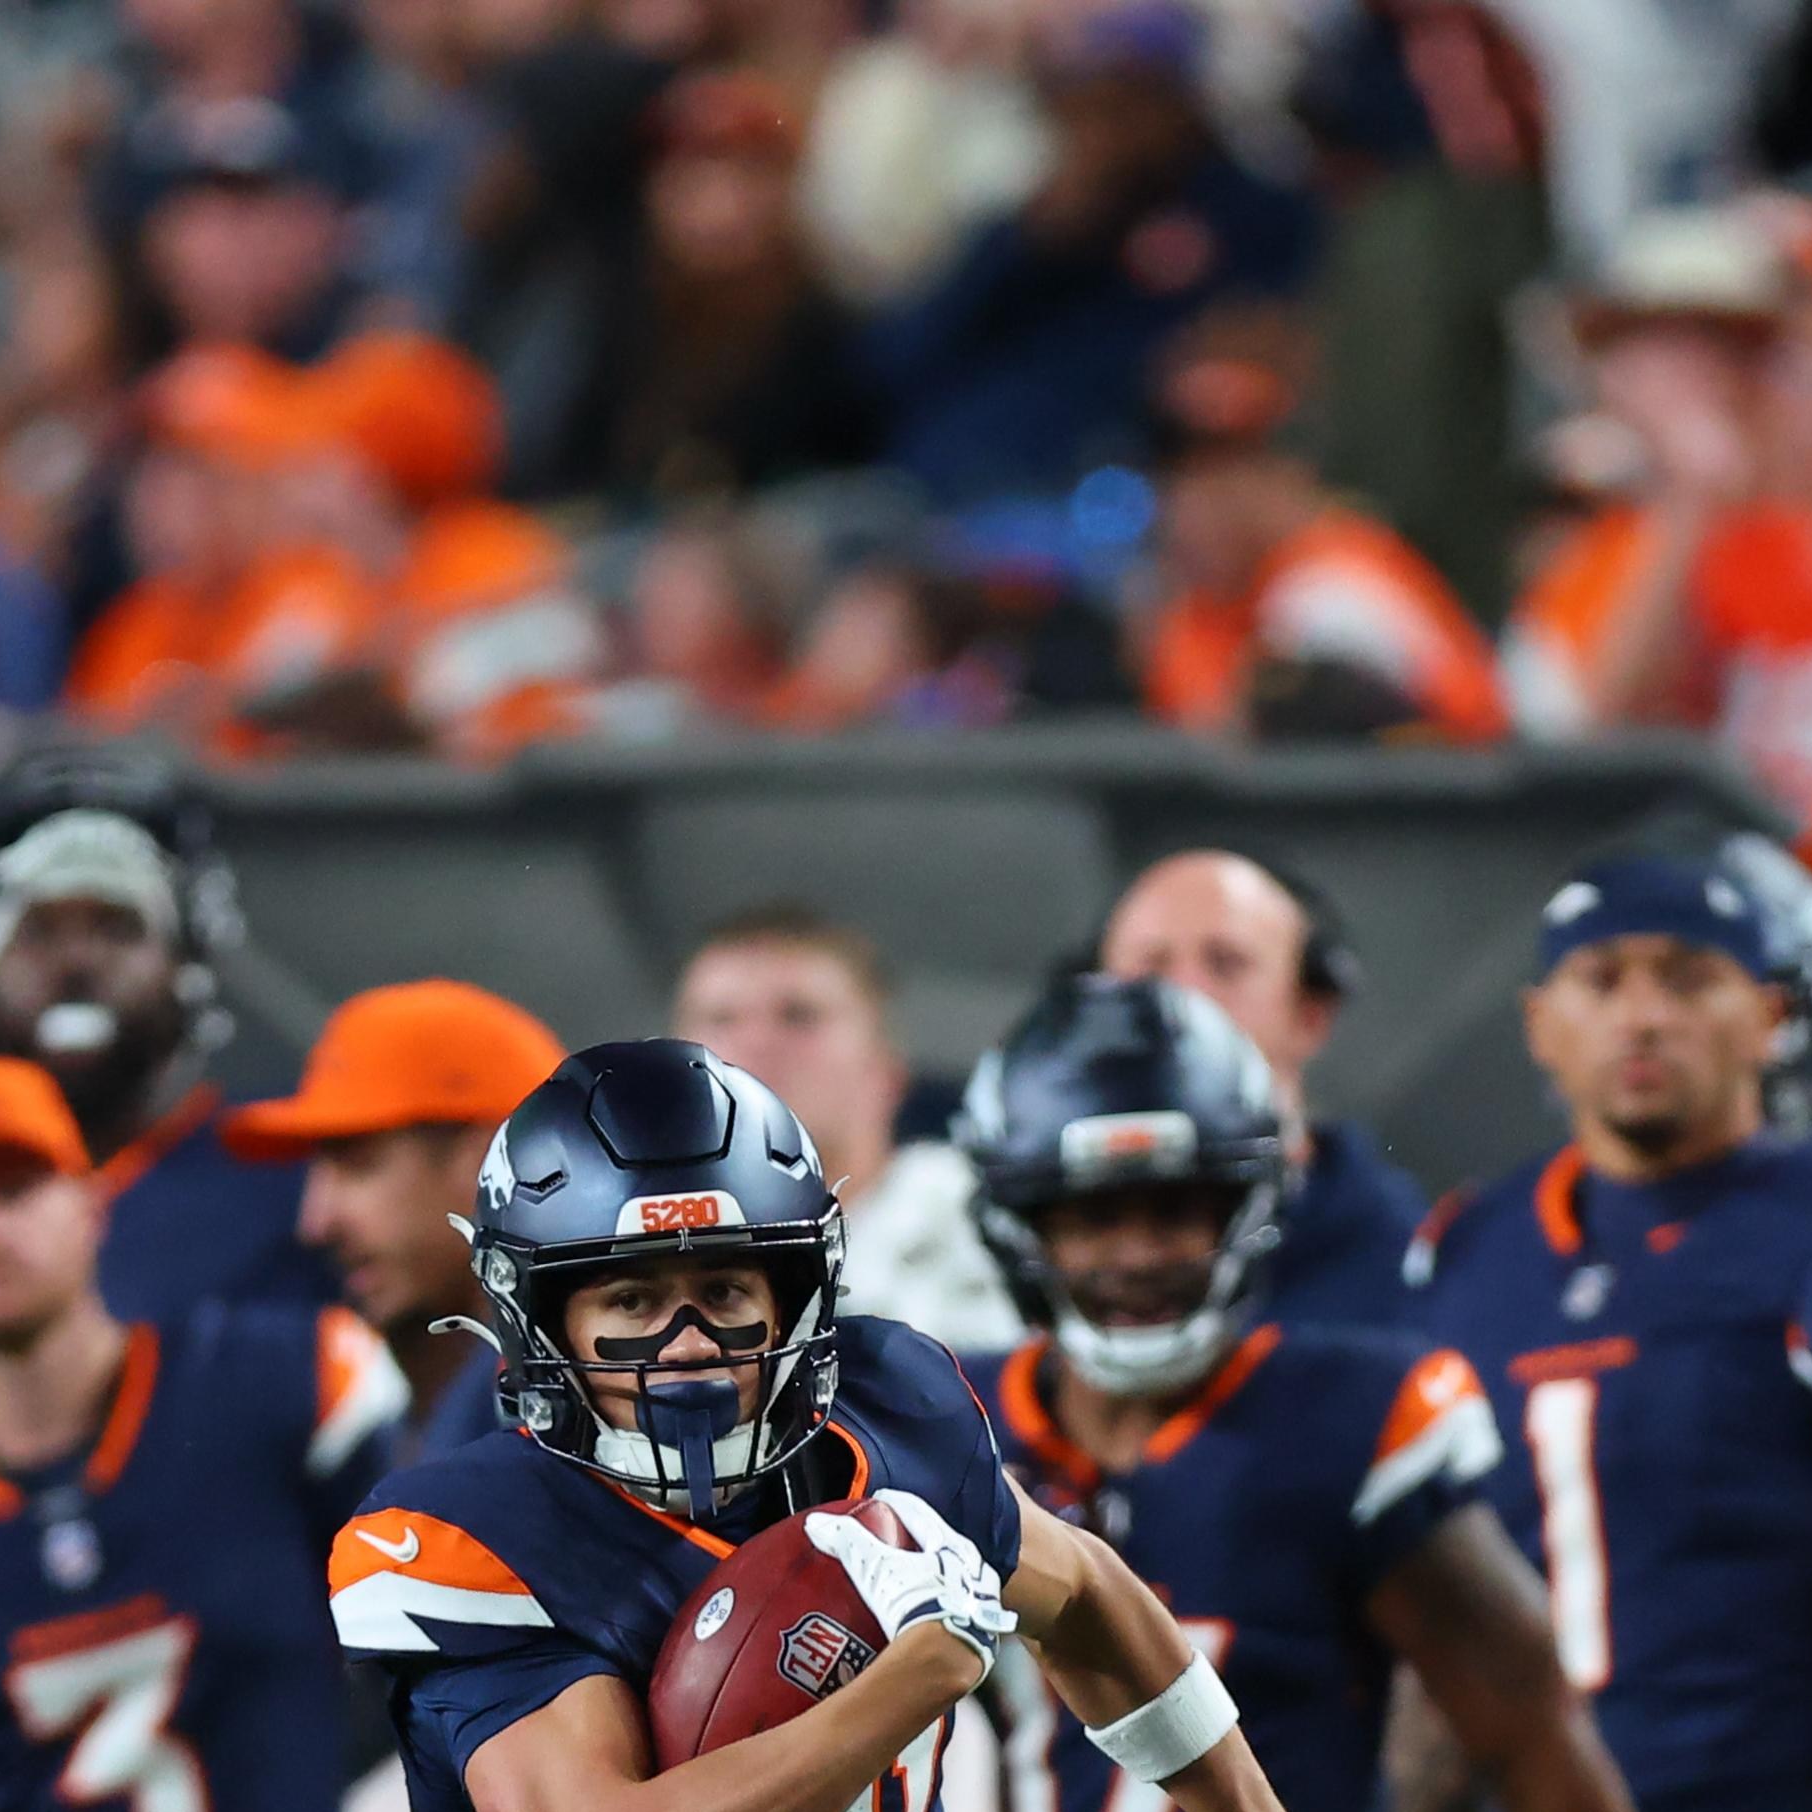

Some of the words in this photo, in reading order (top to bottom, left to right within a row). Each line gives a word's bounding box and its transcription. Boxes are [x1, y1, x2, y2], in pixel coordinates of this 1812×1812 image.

[641, 1196, 719, 1234] 5280
[1524, 1376, 1613, 1692] 1
[787, 1620, 846, 1683] NFL
